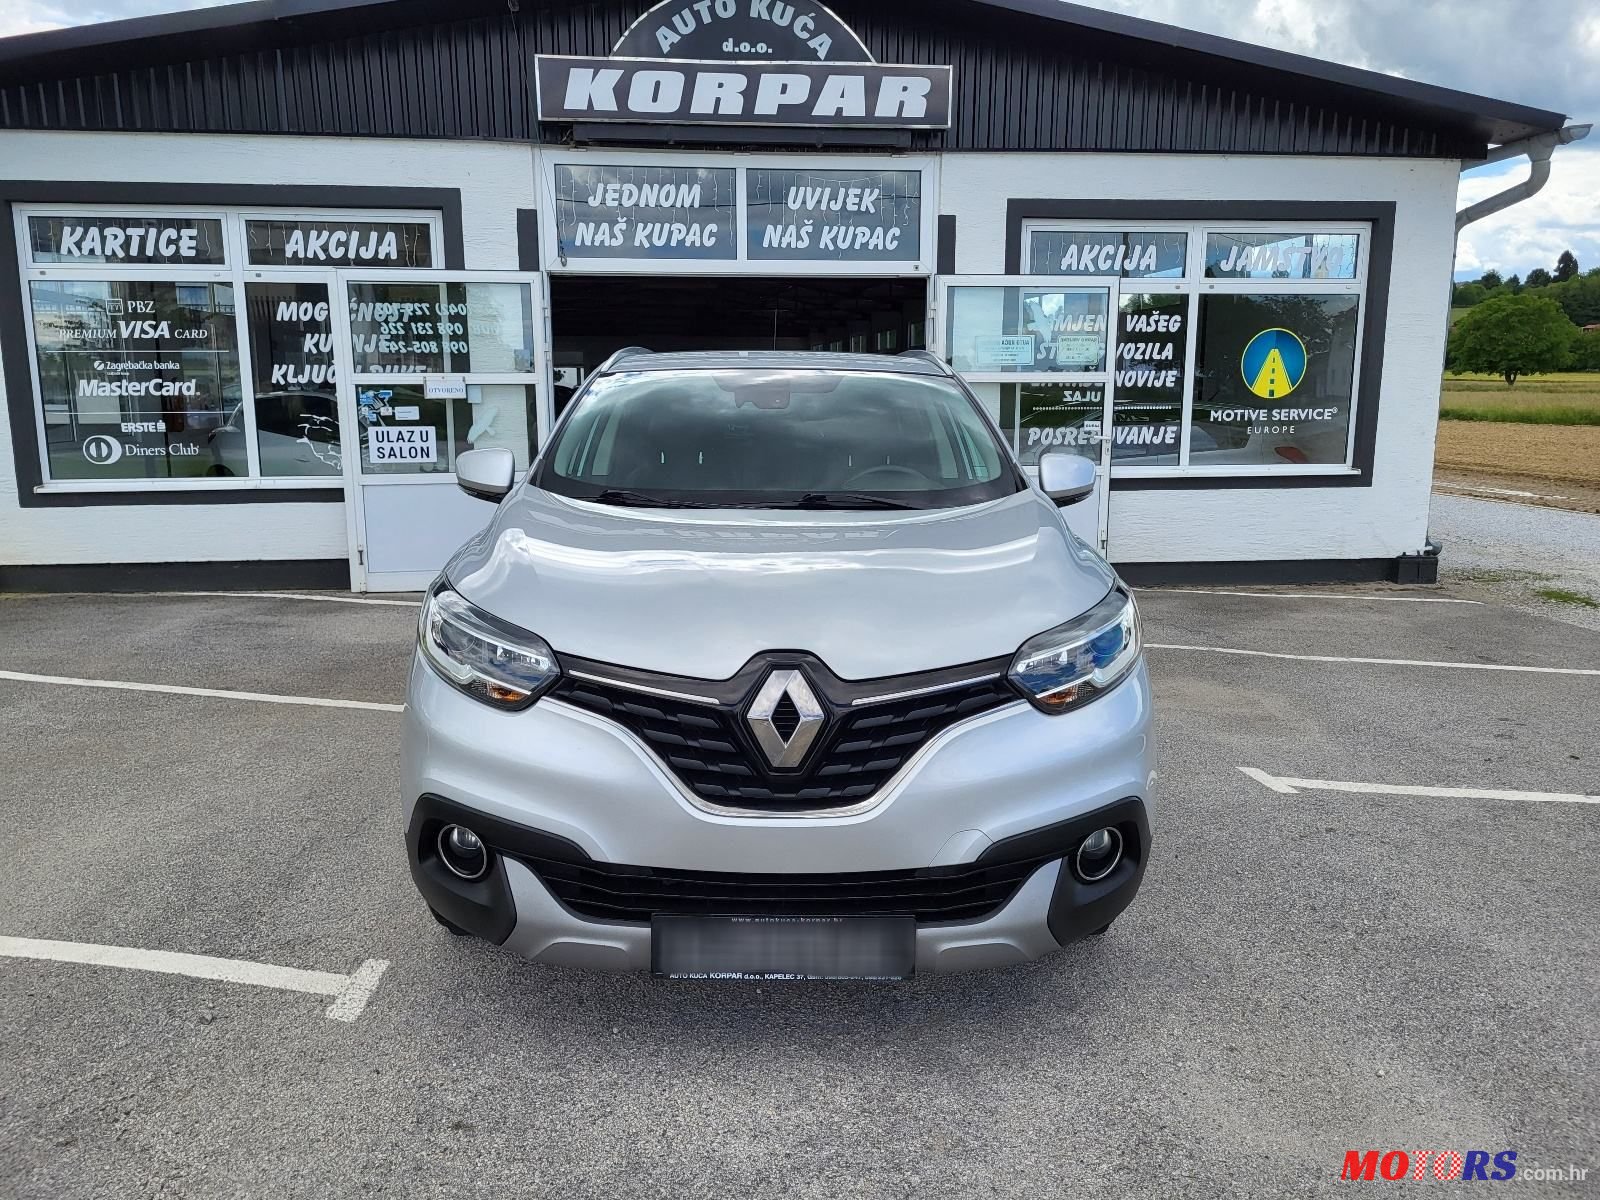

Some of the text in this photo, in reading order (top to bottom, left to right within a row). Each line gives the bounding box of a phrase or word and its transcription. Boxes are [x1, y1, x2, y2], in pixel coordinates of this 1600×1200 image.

[656, 0, 833, 61] AUTO KUĆA
[722, 38, 773, 53] d.o.o.
[563, 67, 932, 119] KORPAR
[587, 183, 702, 209] JEDNOM
[787, 186, 880, 215] UVIJEK
[60, 226, 198, 259] KARTICE
[575, 216, 718, 250] NAŠ KUPAC
[762, 219, 901, 252] NAŠ KUPAC
[285, 230, 398, 261] AKCIJA
[1060, 244, 1158, 273] AKCIJA
[1220, 246, 1344, 272] JAMSTVO
[127, 301, 155, 313] PBZ
[59, 320, 208, 339] PREMIUM VISA CARD
[1126, 310, 1181, 333] VAŠEG
[304, 333, 391, 354] KUNJE
[105, 361, 180, 372] Zagrebačka banka
[1115, 370, 1178, 388] NOVIJE
[1210, 409, 1267, 421] MOTIVE
[121, 422, 156, 433] ERSTE
[375, 430, 429, 443] ULAZ U
[1247, 425, 1295, 434] EUROPE
[125, 444, 166, 456] Diners
[376, 446, 430, 459] SALON
